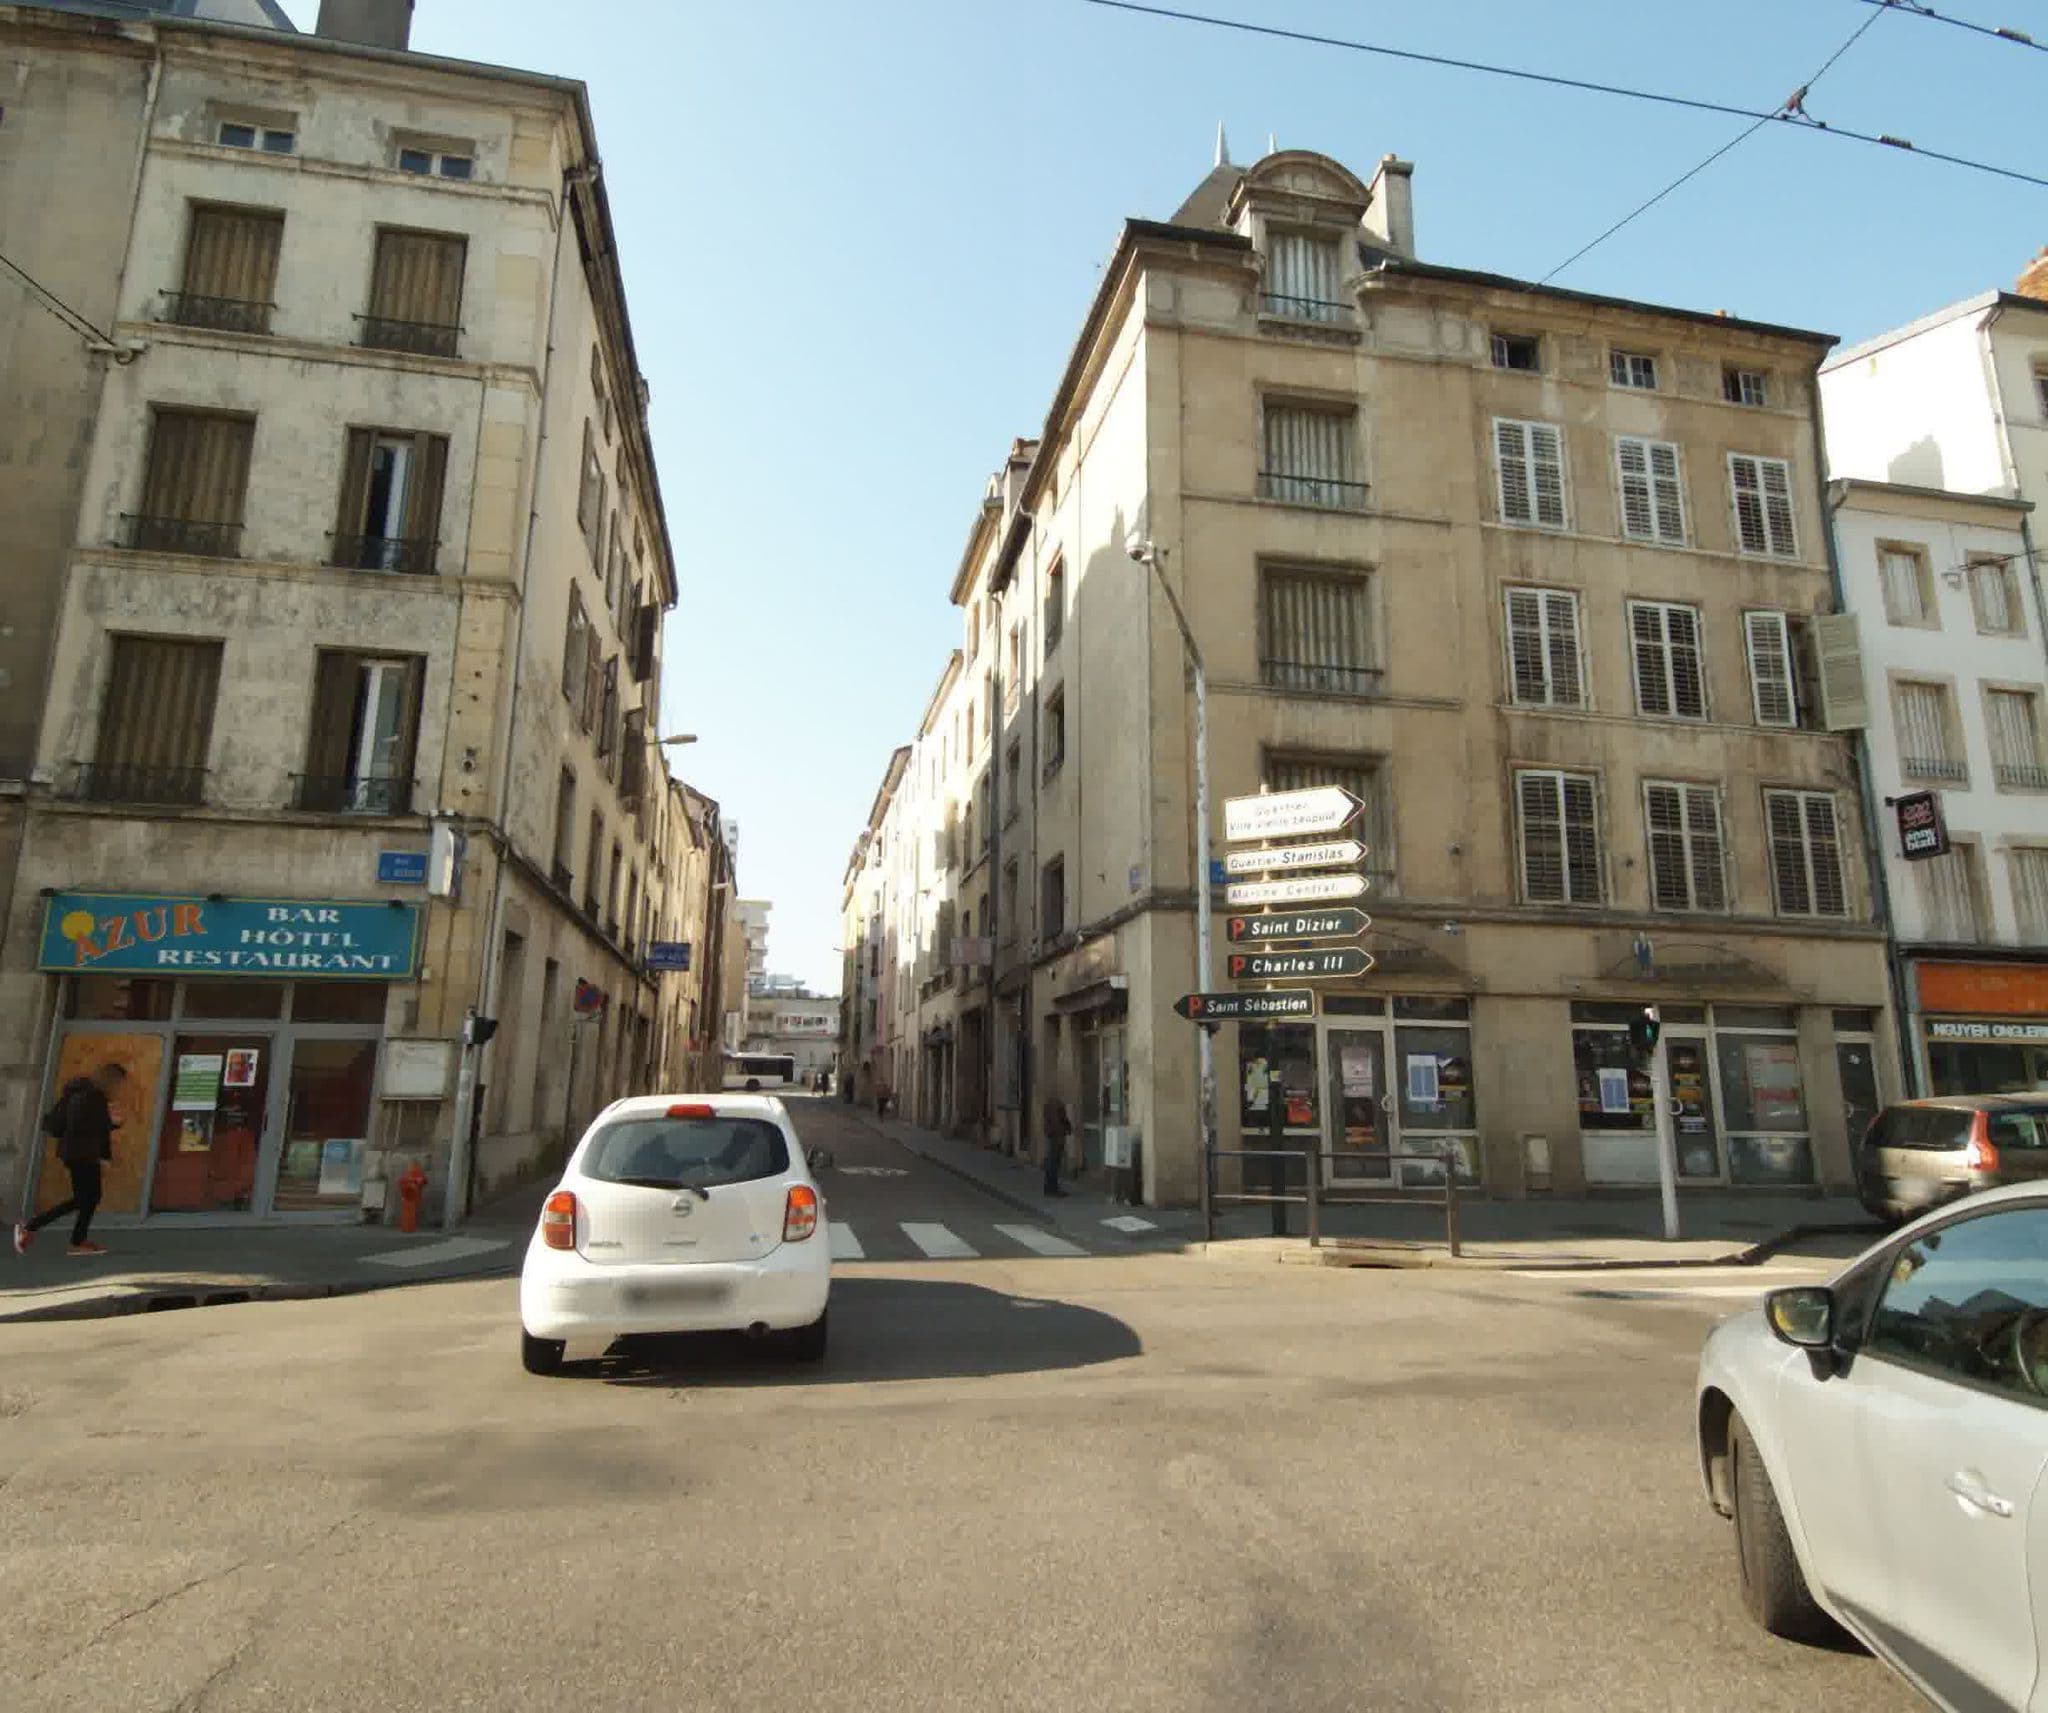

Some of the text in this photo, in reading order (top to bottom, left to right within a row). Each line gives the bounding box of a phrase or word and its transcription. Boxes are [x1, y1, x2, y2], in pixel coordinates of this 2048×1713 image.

[1281, 848, 1345, 864] Stanislas
[1287, 882, 1338, 896] Central
[266, 907, 341, 924] BAR
[1251, 921, 1289, 935] Saint
[1295, 918, 1342, 933] Dizier
[73, 903, 208, 968] AZUR
[239, 927, 361, 948] HÔTEL
[156, 949, 398, 969] RESTAURANT
[1251, 958, 1315, 973] Charles
[1323, 956, 1344, 970] III
[1206, 1000, 1240, 1013] Saint
